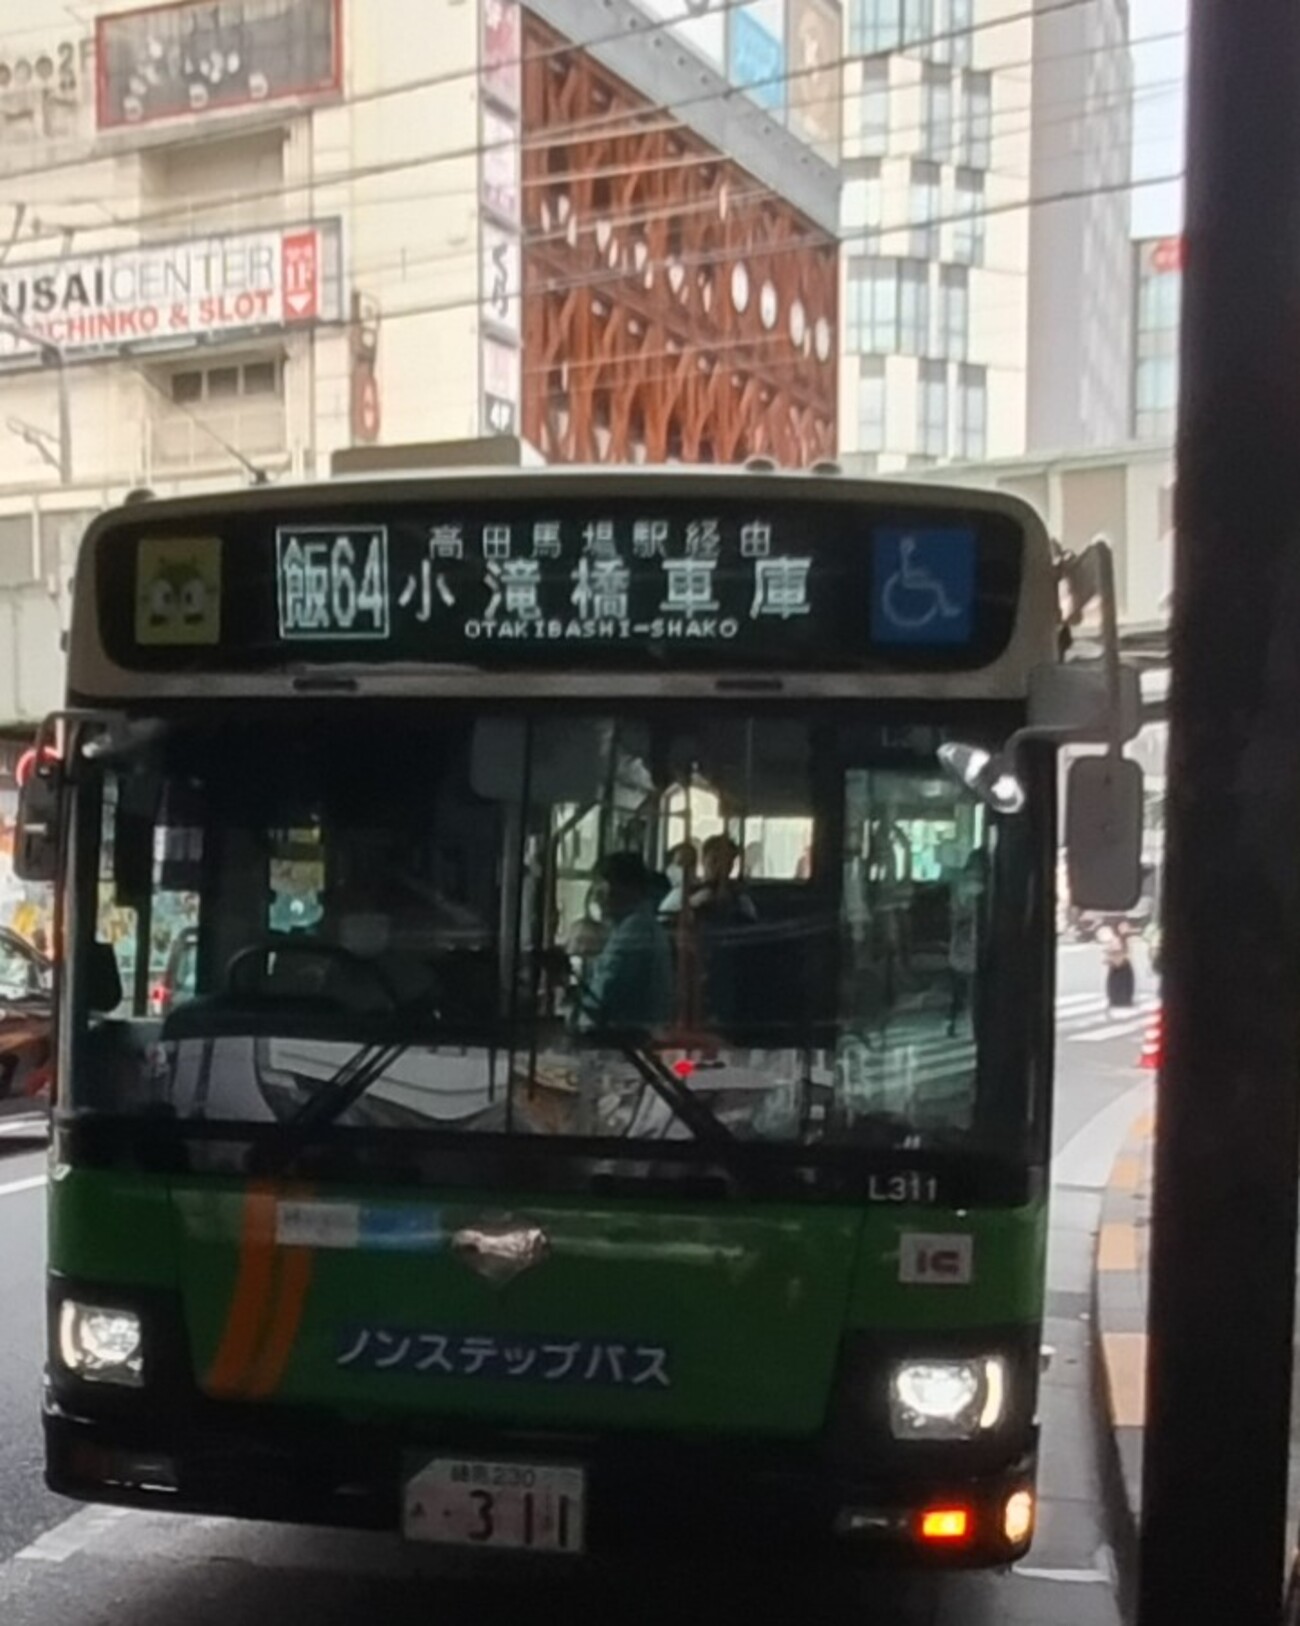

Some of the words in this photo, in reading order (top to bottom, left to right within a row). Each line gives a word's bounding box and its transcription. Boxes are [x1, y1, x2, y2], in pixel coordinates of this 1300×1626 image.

[169, 303, 188, 329] &
[199, 289, 274, 324] SLOT
[429, 520, 771, 560] 高田馬場駅経由
[282, 536, 383, 628] 飯64
[398, 555, 812, 622] 小滝橋車庫
[464, 618, 738, 639] OTAKIBASHI-SHAKO
[869, 1171, 937, 1202] L311
[336, 1329, 671, 1387] ノンステップバス
